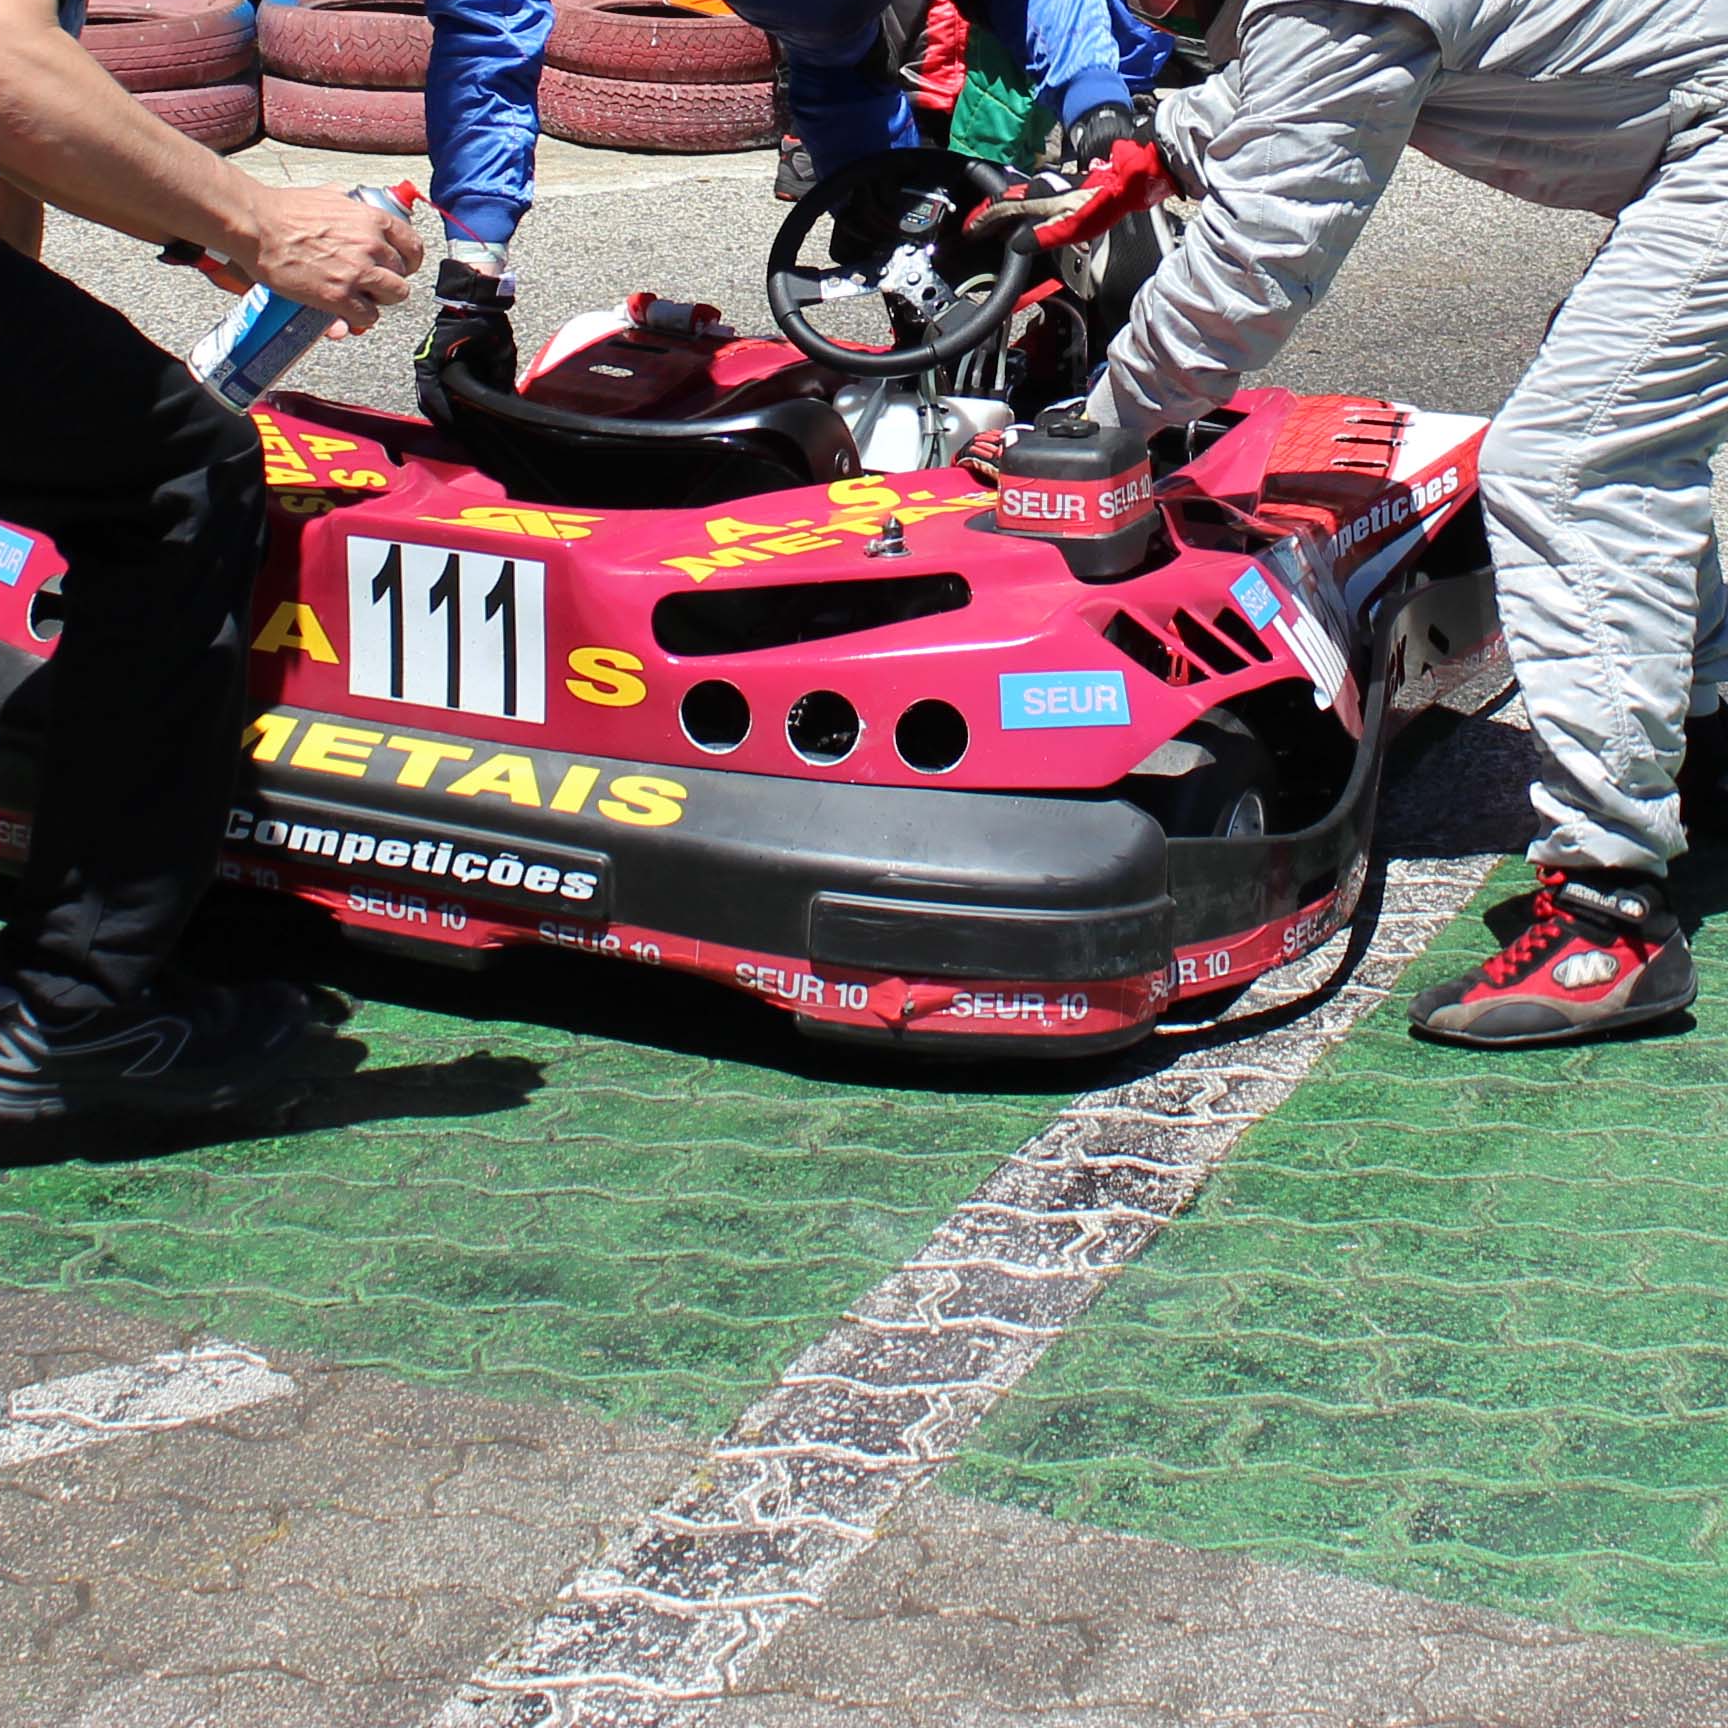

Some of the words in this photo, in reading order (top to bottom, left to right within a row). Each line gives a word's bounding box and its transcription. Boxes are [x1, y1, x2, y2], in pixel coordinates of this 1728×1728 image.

[1003, 488, 1086, 522] SEUR
[1098, 479, 1139, 519] SEUR
[1139, 473, 1152, 500] 10
[1240, 578, 1275, 617] SEUR
[372, 543, 517, 716] 111
[1023, 685, 1118, 715] SEUR
[224, 808, 599, 902] Competições
[346, 884, 427, 925] SEUR
[438, 901, 468, 931] 10
[538, 920, 622, 960] SEUR
[629, 940, 661, 966] 10
[1204, 950, 1231, 977] 10
[735, 962, 826, 1005] SEUR
[835, 980, 869, 1011] 10
[950, 991, 1047, 1021] SEUR
[1056, 991, 1089, 1022] 10
